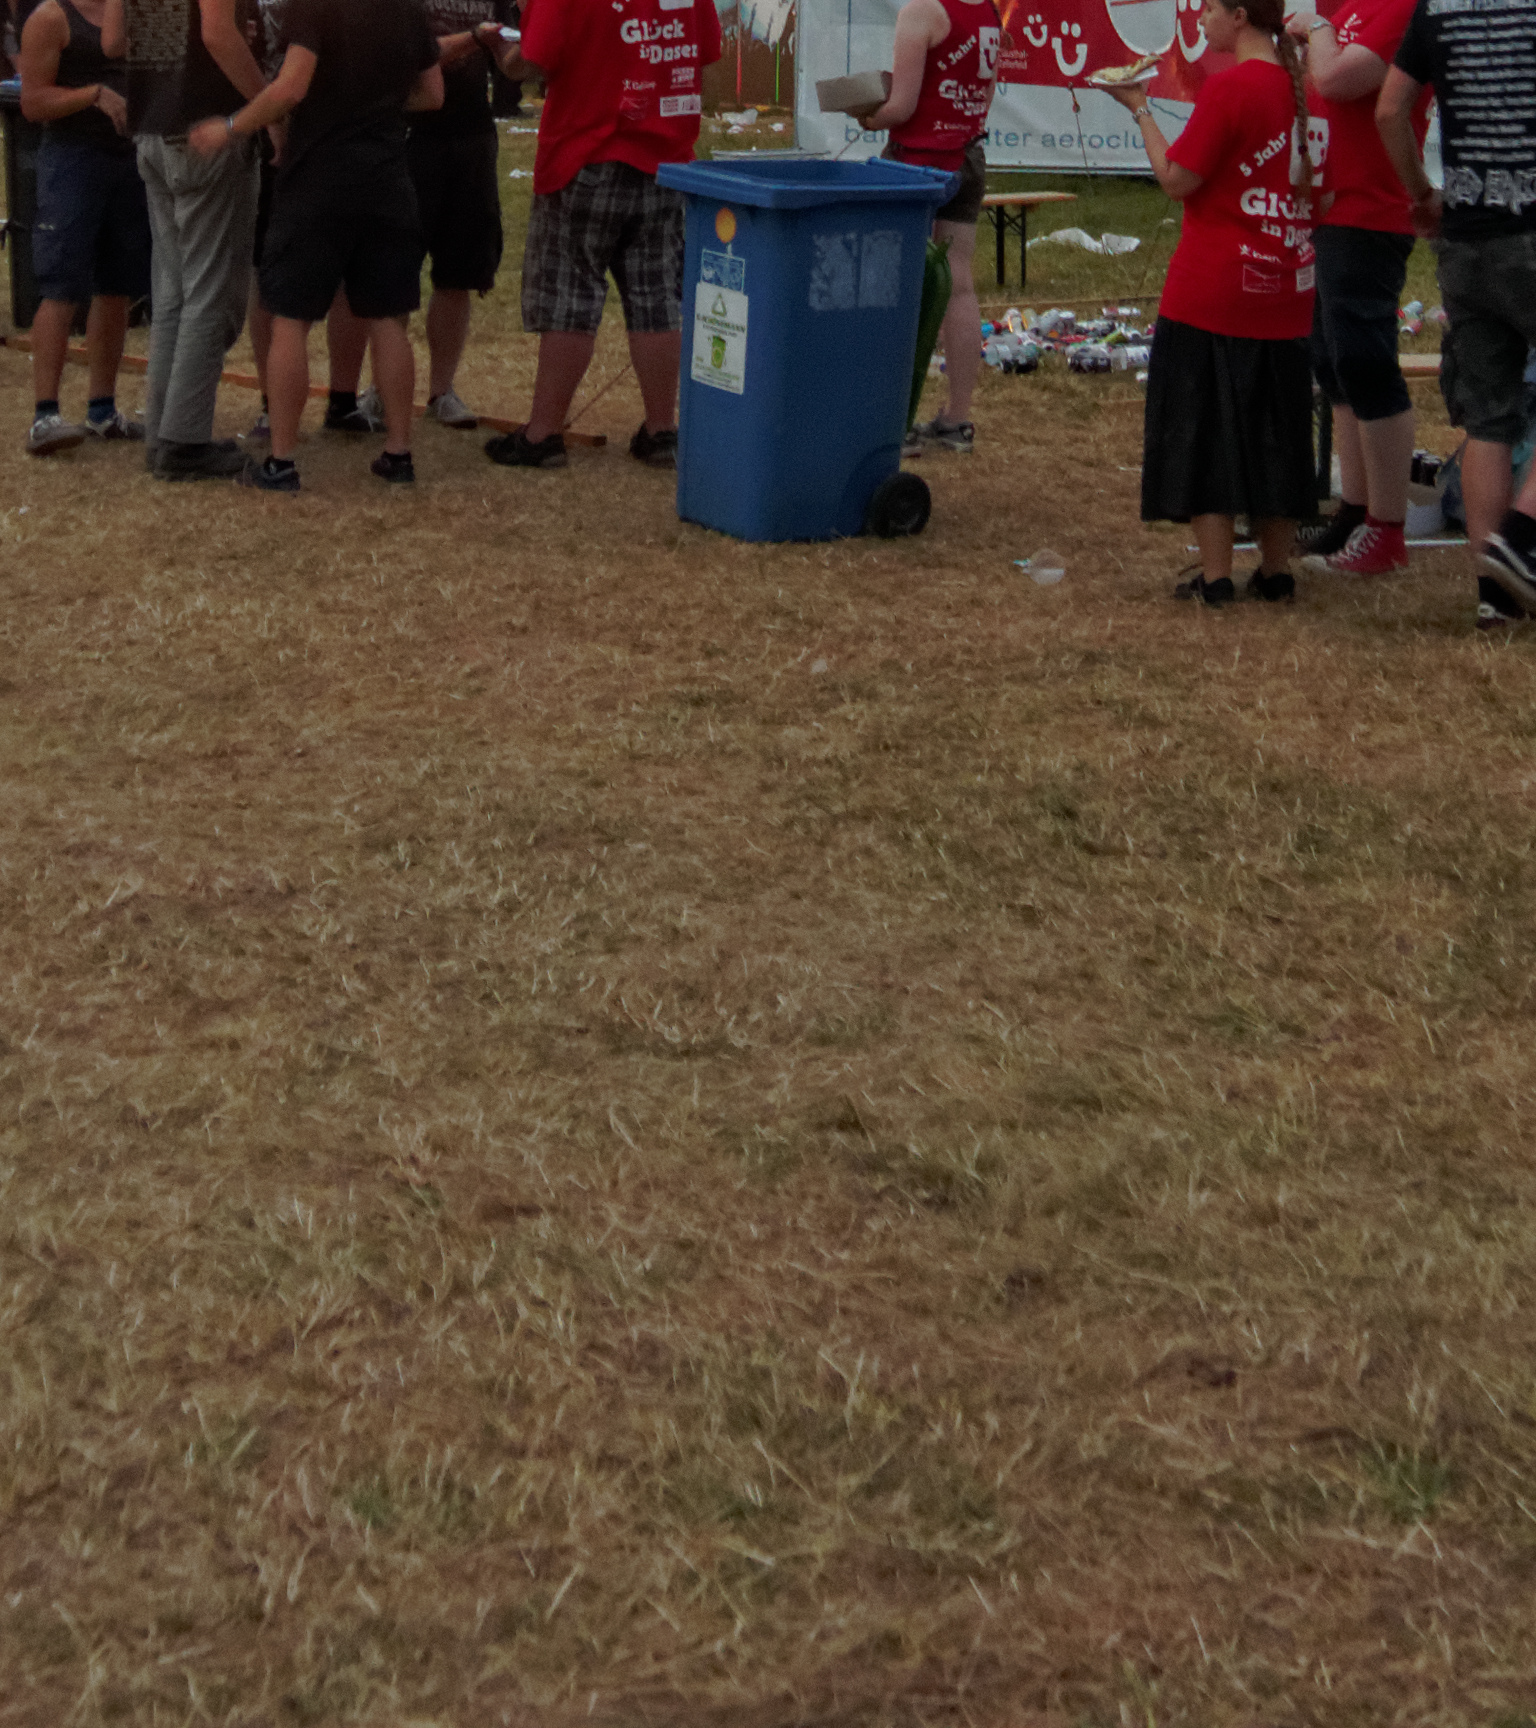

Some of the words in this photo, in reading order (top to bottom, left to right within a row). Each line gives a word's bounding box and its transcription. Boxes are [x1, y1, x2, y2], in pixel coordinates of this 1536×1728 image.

[1041, 127, 1147, 151] aeroclu
[1238, 161, 1253, 178] 5
[1253, 131, 1287, 168] Jahr
